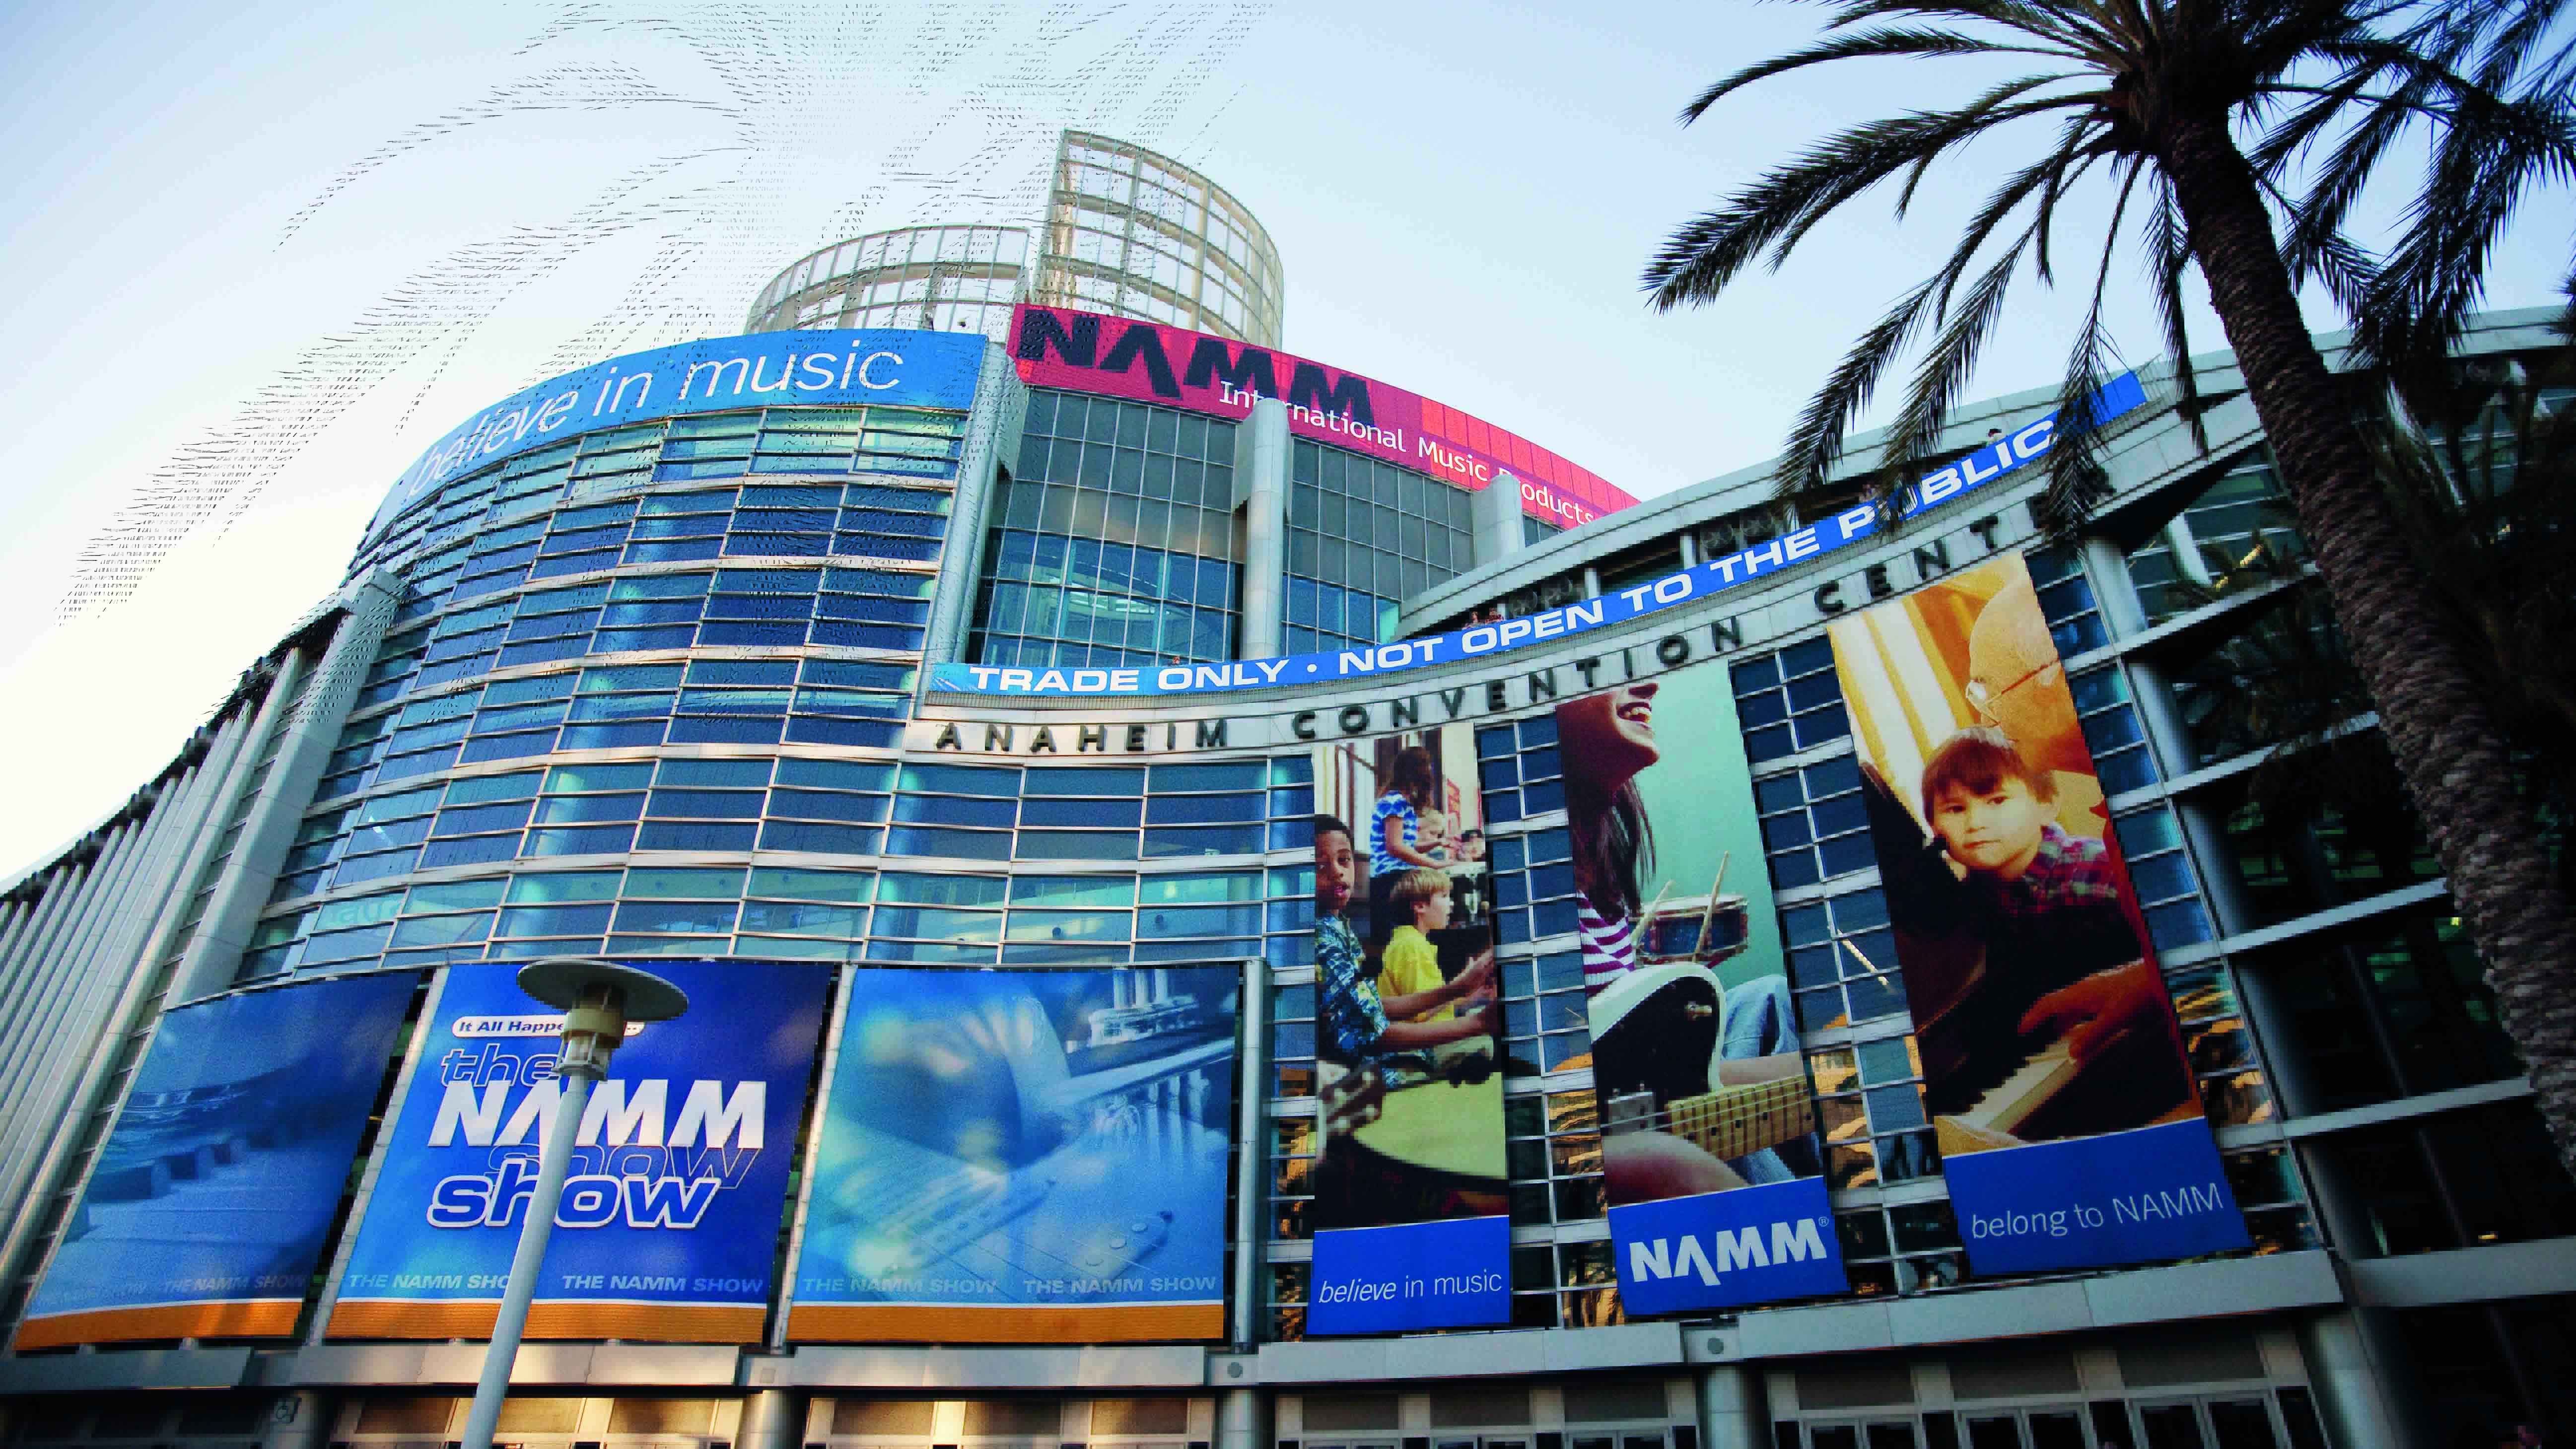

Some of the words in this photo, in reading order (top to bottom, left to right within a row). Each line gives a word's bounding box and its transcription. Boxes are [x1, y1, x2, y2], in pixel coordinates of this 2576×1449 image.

[1018, 309, 1374, 426] NAMM
[408, 390, 579, 497] believe
[591, 366, 653, 416] in
[678, 340, 904, 400] music
[1219, 380, 1406, 453] Intnational
[1418, 436, 1488, 482] Music
[1498, 467, 1594, 525] oducts
[970, 667, 1139, 692] TRADE
[1157, 659, 1289, 690] ONLY
[1338, 637, 1444, 675] NOT
[1462, 599, 1604, 654] OPEN
[1620, 574, 1693, 612] TO
[1710, 527, 1820, 583] THE
[935, 718, 1226, 753] ANAHEIM
[1292, 615, 1742, 739] CONVENTION
[459, 1021, 473, 1032] It
[477, 1021, 503, 1032] All
[507, 1021, 564, 1034] Happe
[440, 1042, 565, 1087] the
[427, 1079, 766, 1149] NAMM
[426, 1158, 721, 1229] show
[1971, 1210, 2068, 1239] belong
[2073, 1203, 2104, 1229] to
[2112, 1183, 2224, 1224] NAMM
[349, 1274, 389, 1288] THE
[392, 1274, 461, 1289] NAMM
[467, 1275, 509, 1289] SHO
[562, 1275, 604, 1289] THE
[610, 1275, 687, 1291] NAMM
[693, 1278, 764, 1294] SHOW
[802, 1278, 843, 1293] THE
[849, 1278, 922, 1293] NAMM
[929, 1278, 998, 1294] SHOW
[1023, 1278, 1064, 1294] THE
[1071, 1277, 1143, 1293] NAMM
[1150, 1276, 1216, 1292] SHOW
[1318, 1275, 1396, 1305] believe
[1404, 1275, 1424, 1298] in
[1434, 1268, 1503, 1296] music
